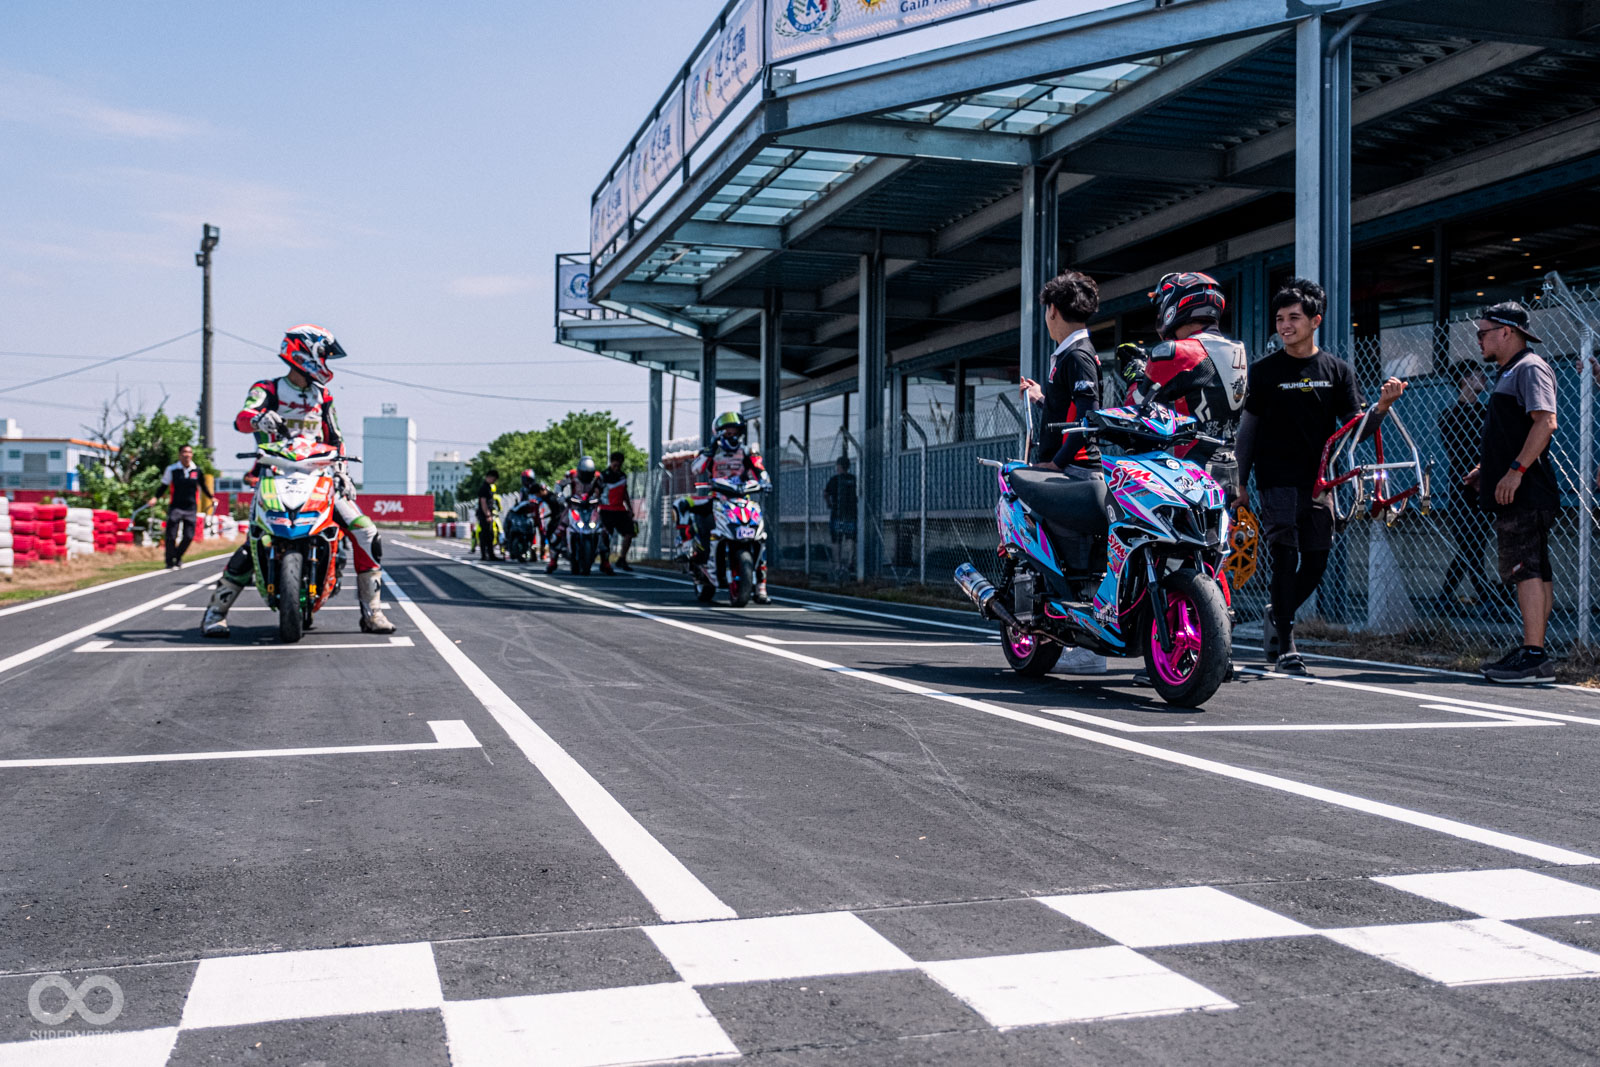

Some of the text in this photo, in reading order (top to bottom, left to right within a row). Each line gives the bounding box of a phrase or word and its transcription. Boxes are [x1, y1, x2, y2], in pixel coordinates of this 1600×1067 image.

[900, 0, 929, 13] Gain
[1109, 467, 1153, 490] SYM
[373, 500, 404, 515] SYM
[1108, 534, 1126, 558] SYM
